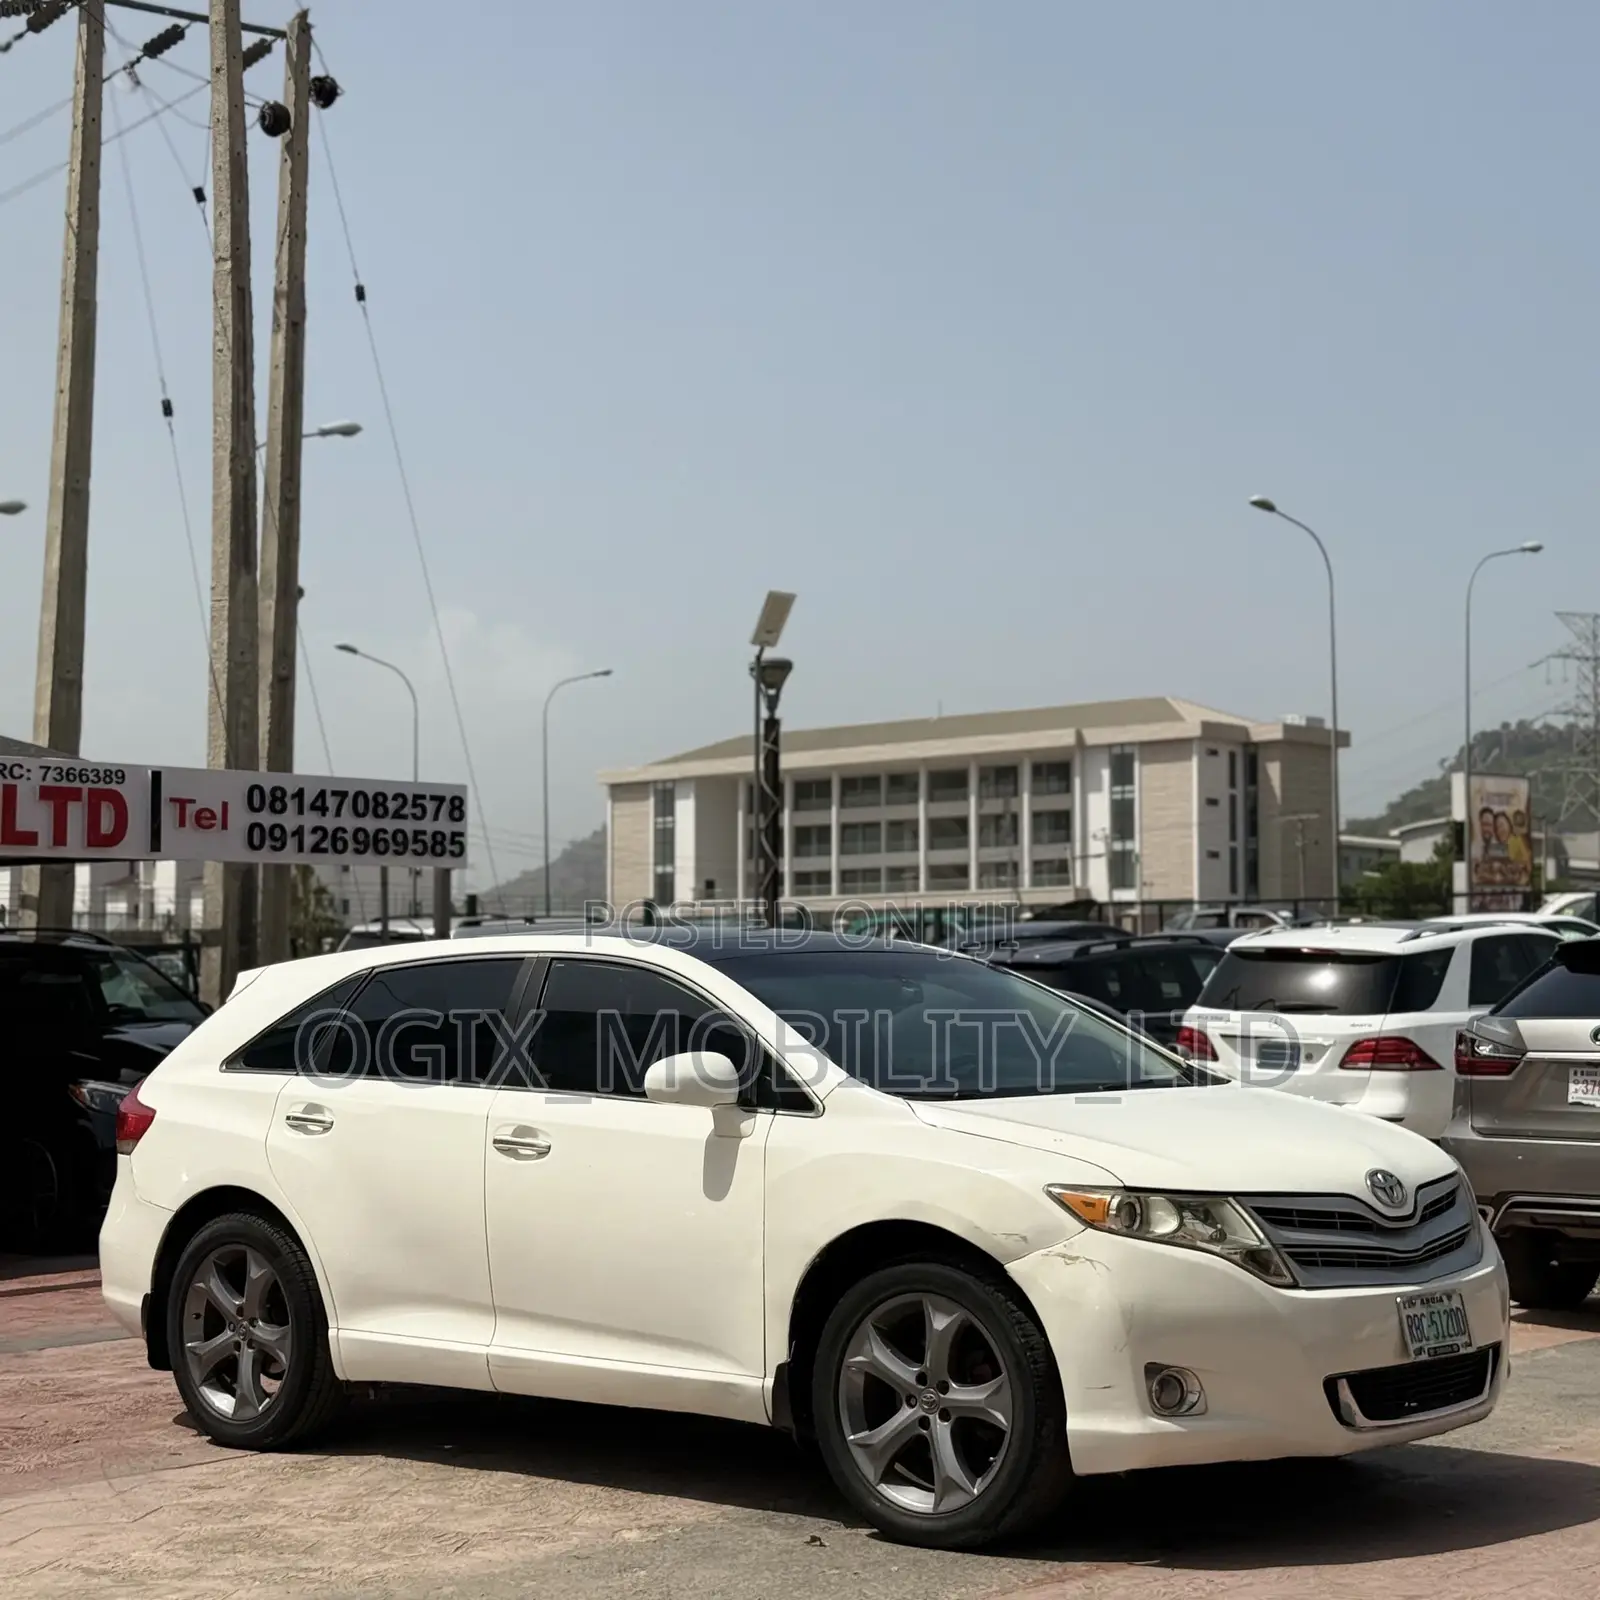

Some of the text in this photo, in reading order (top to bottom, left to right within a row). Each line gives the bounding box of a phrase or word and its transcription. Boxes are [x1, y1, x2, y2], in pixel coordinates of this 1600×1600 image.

[39, 765, 126, 785] 7366389
[1, 783, 128, 848] LTD
[169, 797, 229, 830] Tel
[247, 784, 465, 822] 08147082578
[247, 822, 465, 858] 09126969585
